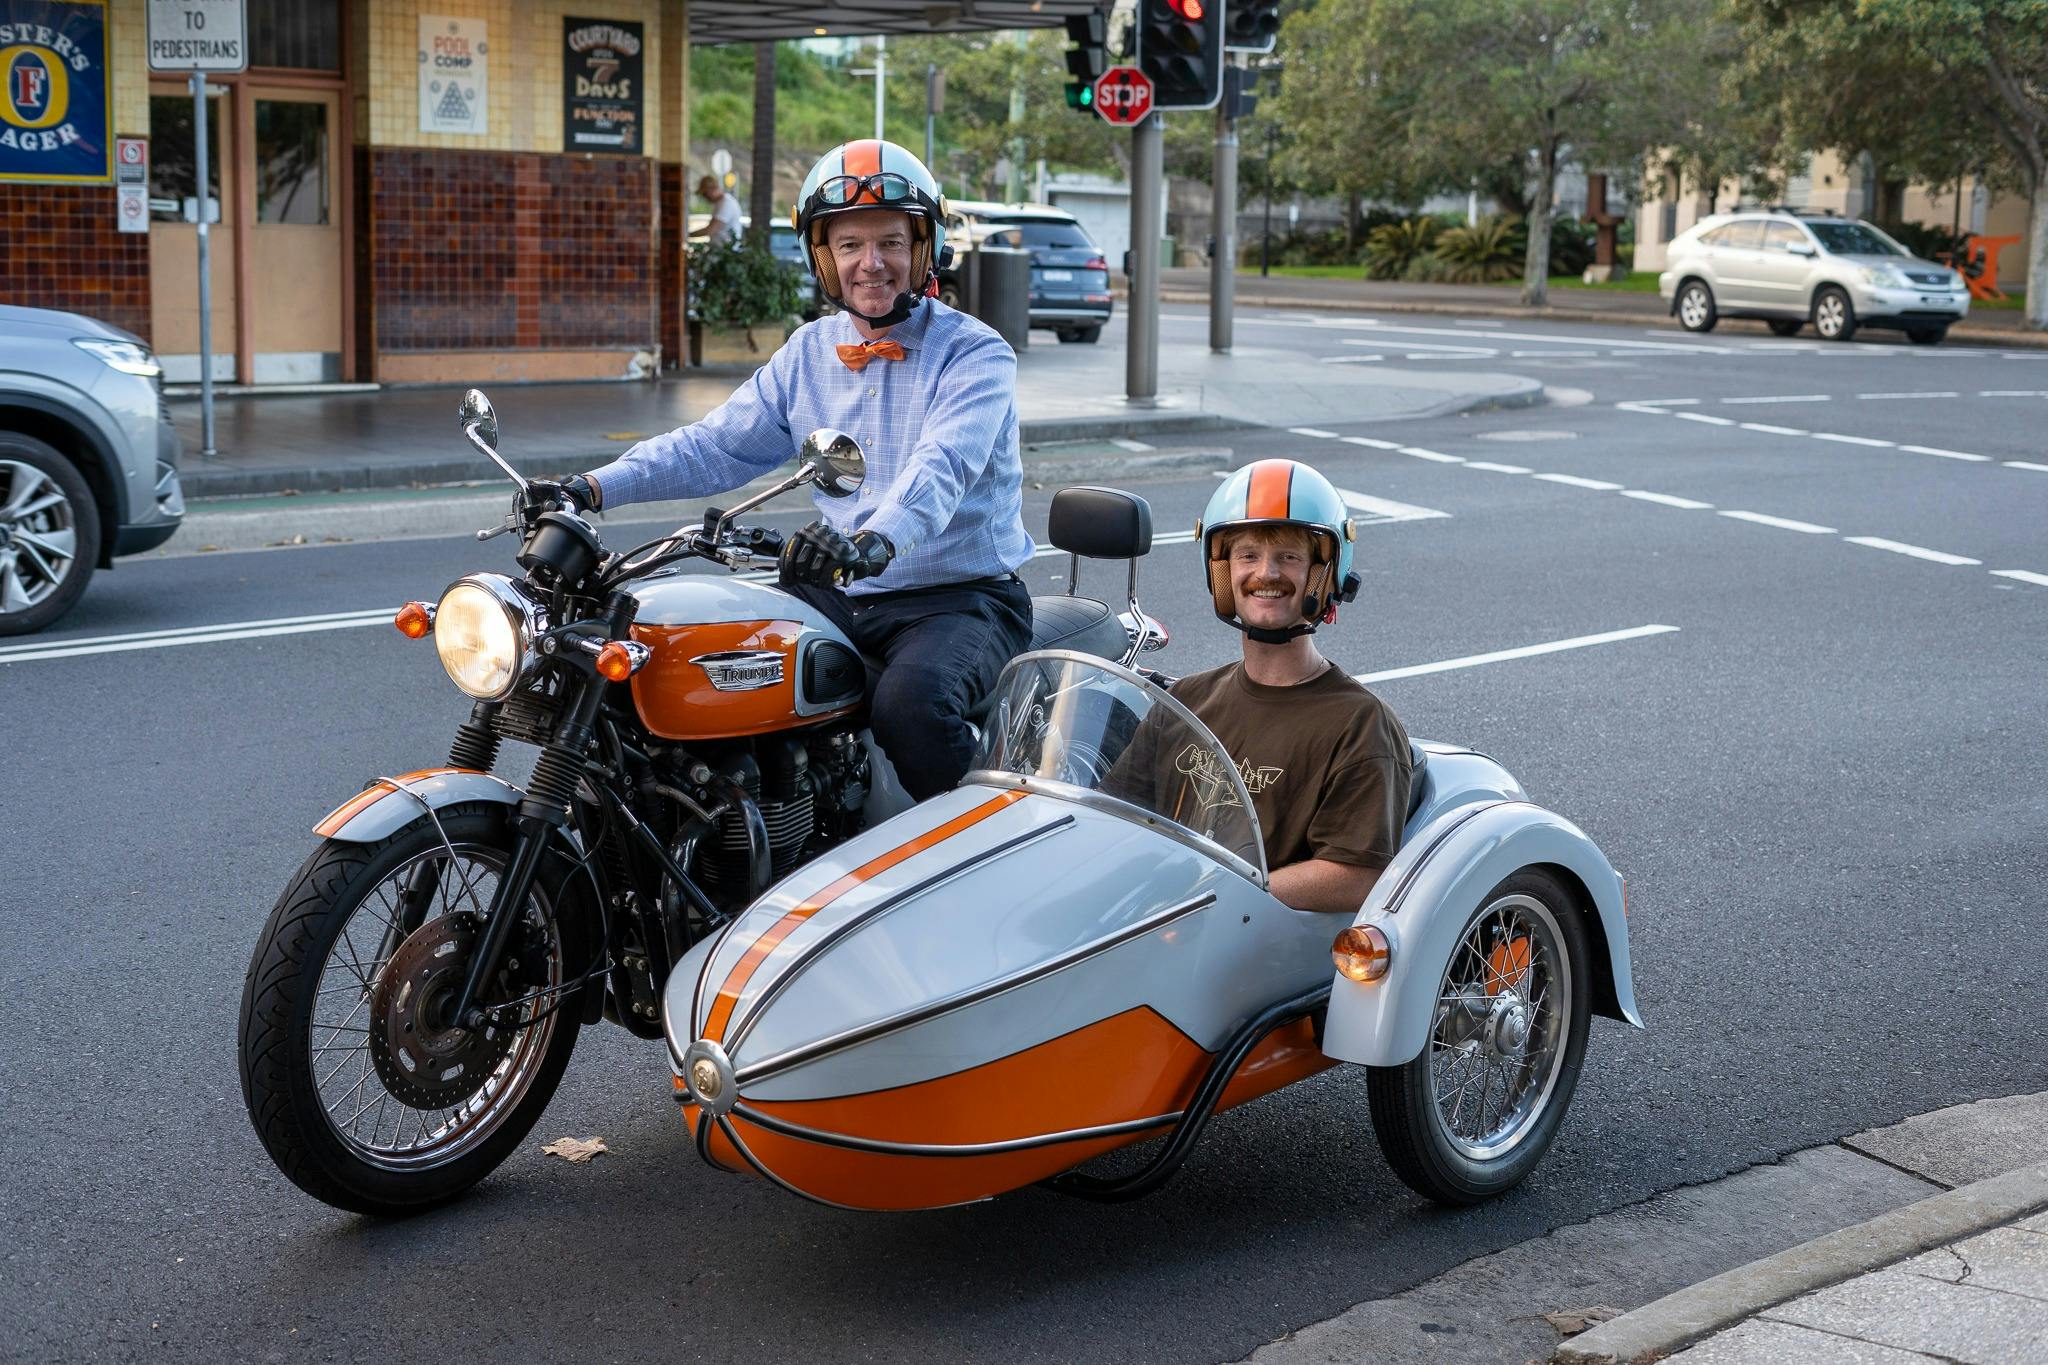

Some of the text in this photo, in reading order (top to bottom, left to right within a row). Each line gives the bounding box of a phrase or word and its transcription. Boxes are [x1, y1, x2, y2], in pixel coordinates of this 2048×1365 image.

[184, 10, 205, 30] TO
[152, 40, 239, 59] PEDESTRIANS
[433, 35, 471, 56] POOL
[568, 25, 640, 56] COURTYARD
[434, 55, 473, 68] COMP
[586, 58, 620, 84] 7
[15, 66, 46, 108] F
[1100, 83, 1149, 107] STOP
[0, 122, 80, 151] AGER
[721, 665, 780, 683] TRIUMPH
